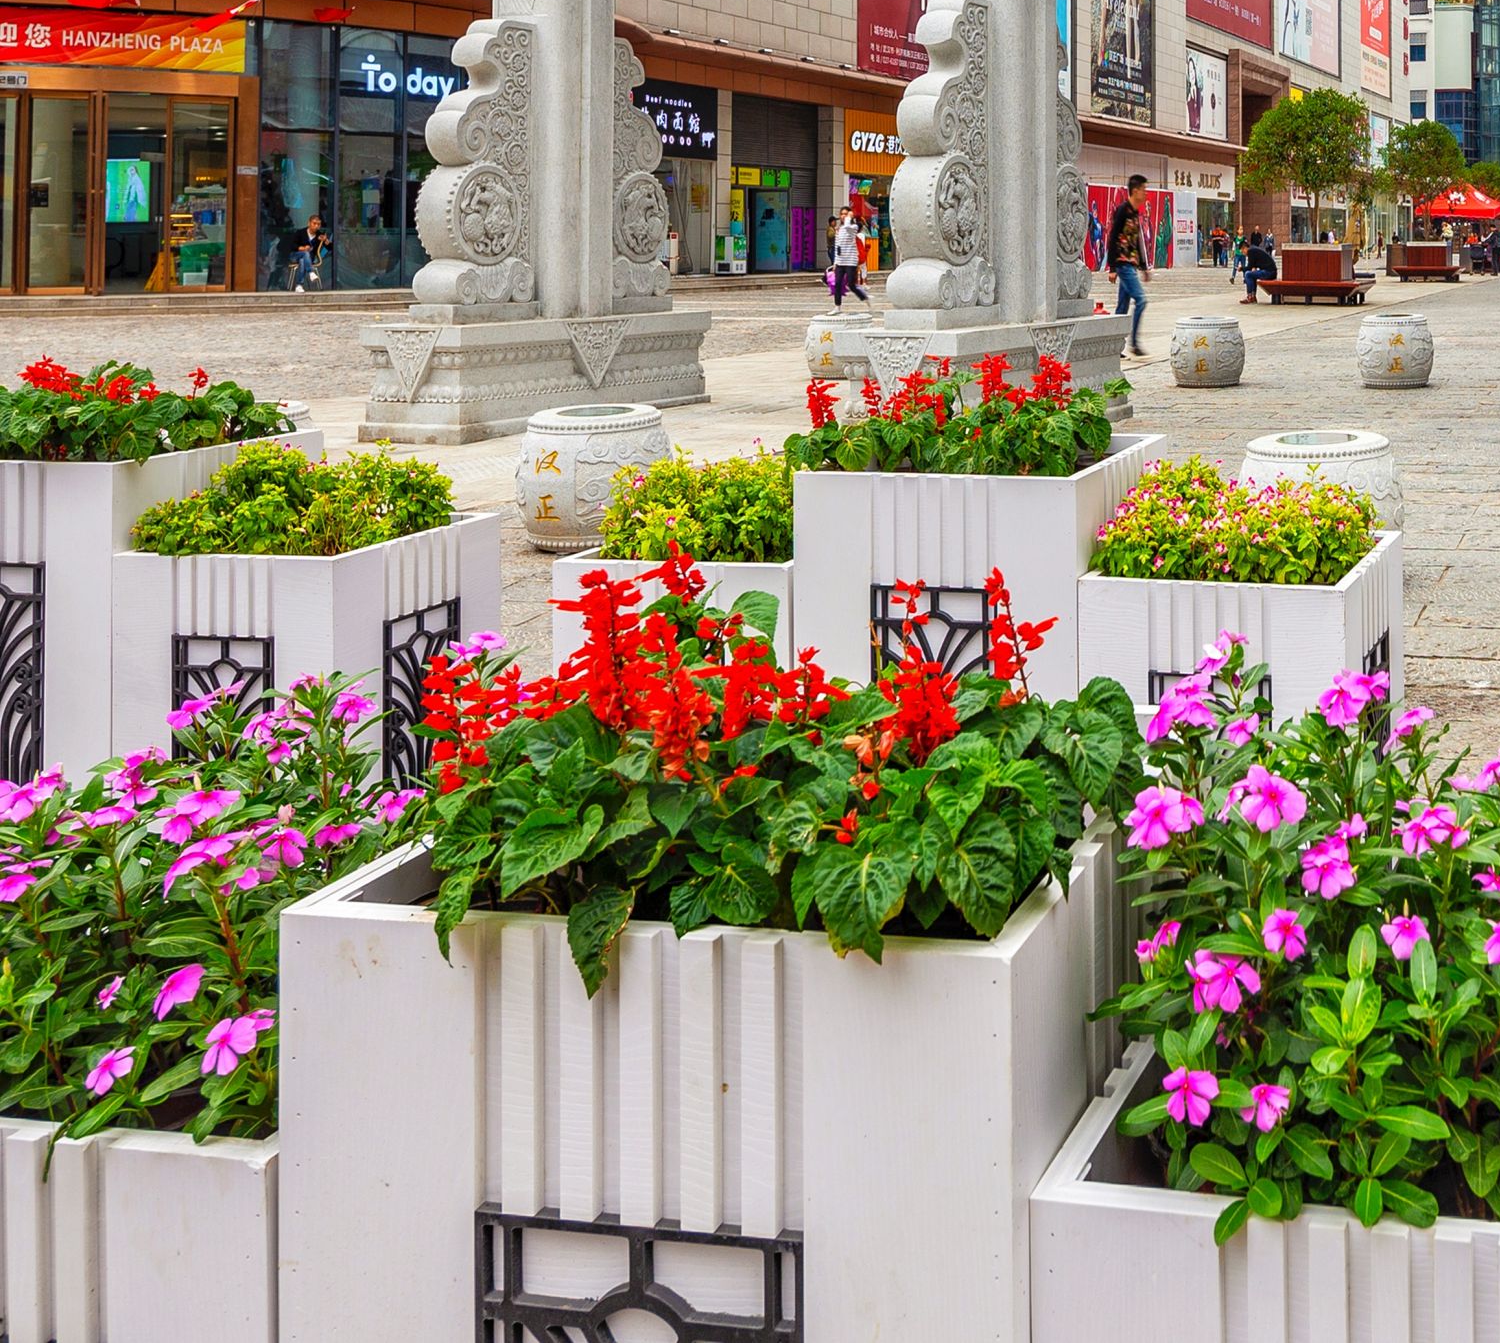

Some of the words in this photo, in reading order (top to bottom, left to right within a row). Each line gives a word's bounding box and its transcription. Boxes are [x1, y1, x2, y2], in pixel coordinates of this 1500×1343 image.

[62, 30, 161, 50] HANZHENG
[169, 36, 224, 54] PLAZA
[665, 98, 692, 108] noodles
[851, 130, 885, 154] GYZG
[534, 448, 561, 522] 汉正
